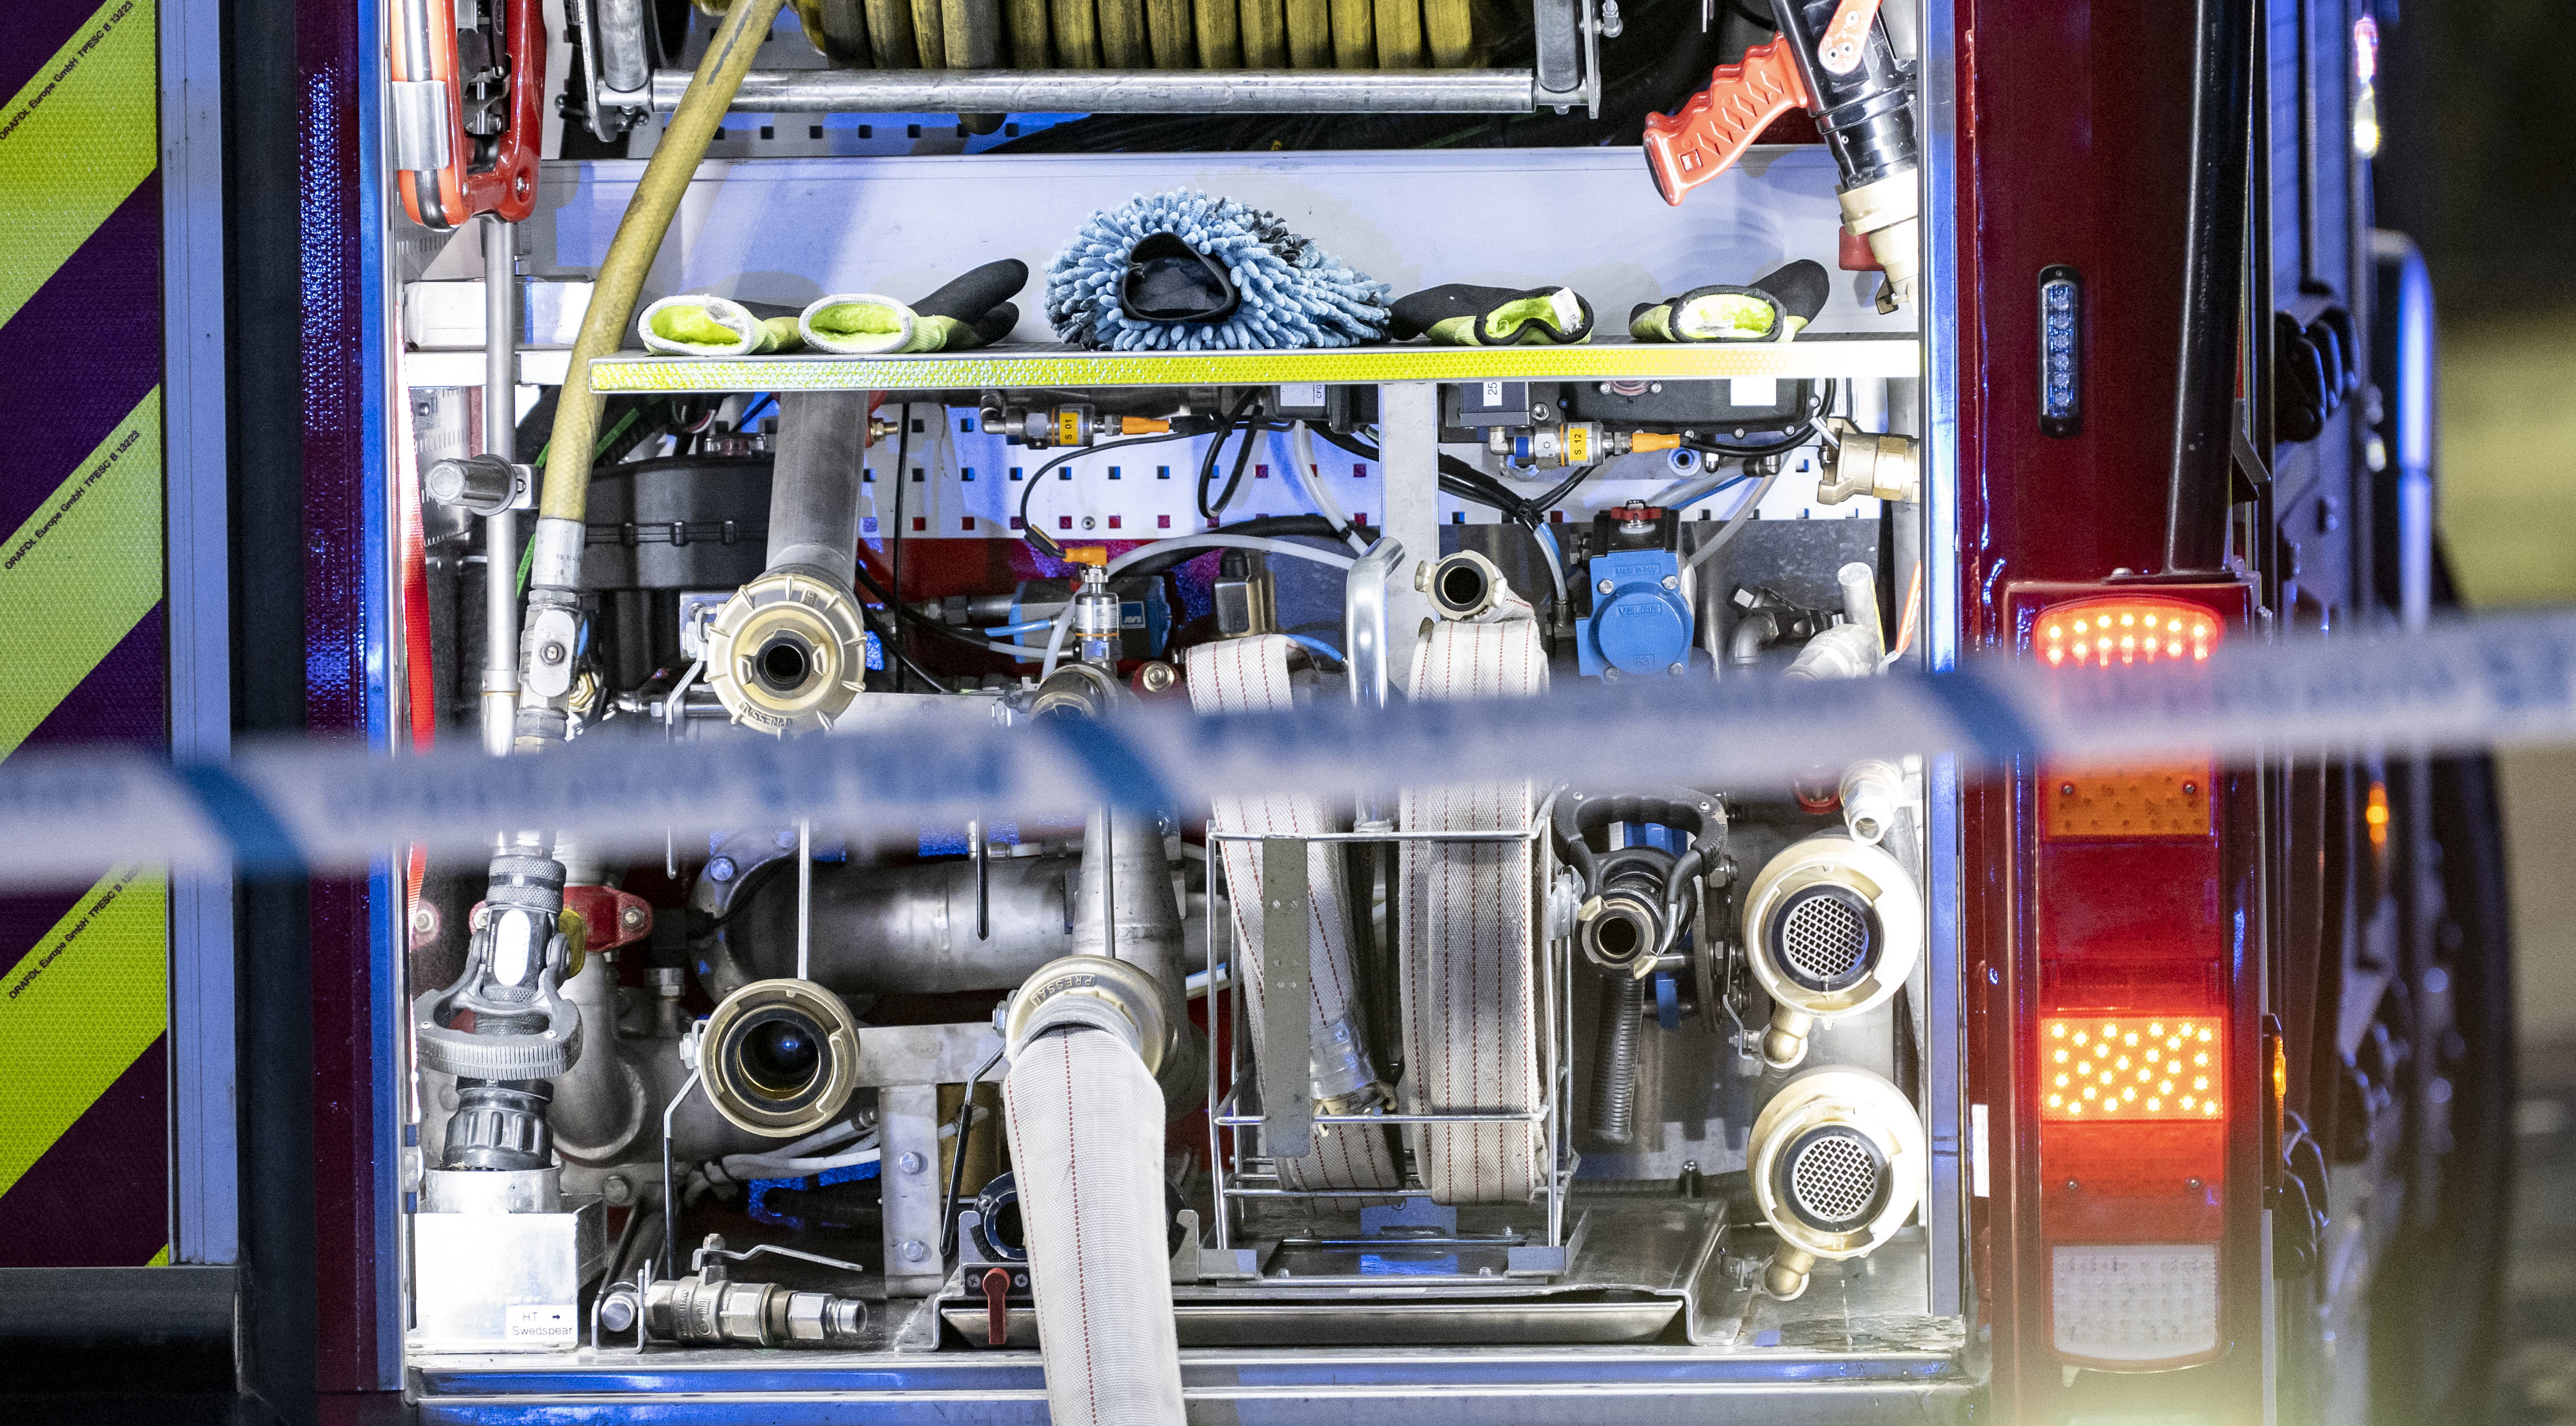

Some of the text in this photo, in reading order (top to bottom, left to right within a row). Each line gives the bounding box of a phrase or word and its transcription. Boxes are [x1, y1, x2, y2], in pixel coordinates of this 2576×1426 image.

[0, 1, 134, 140] ORAFOL Europe GmbH TPESC B 13223
[1065, 420, 1072, 429] 01
[1574, 434, 1582, 444] 12
[4, 430, 140, 570] ORAFOL Europe GmbH TPESC B 13223
[8, 968, 42, 1000] ORAFOL
[39, 942, 67, 968] Europe
[64, 917, 90, 943] GmbH
[88, 891, 116, 918] TPESC
[114, 884, 122, 892] B
[1032, 976, 1093, 1004] PRESSAL
[523, 1312, 538, 1321] HT
[512, 1325, 573, 1336] Swedspear
